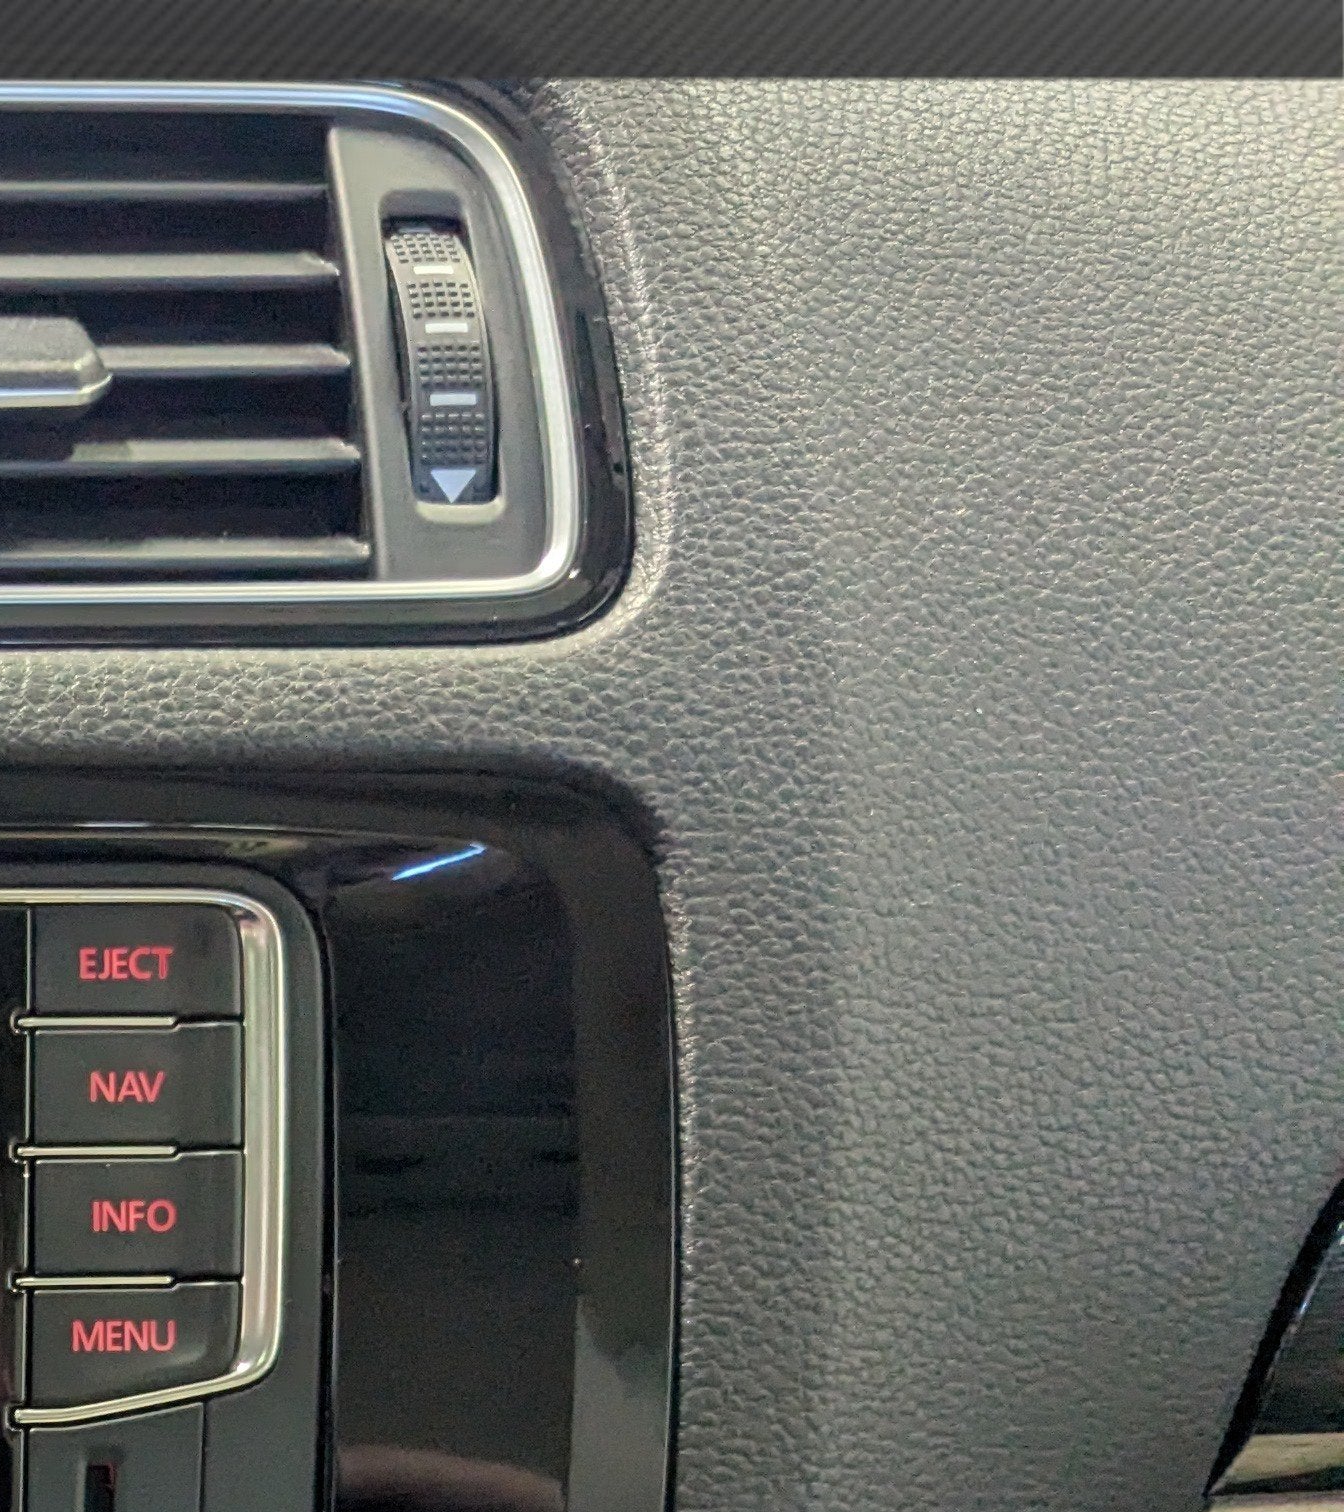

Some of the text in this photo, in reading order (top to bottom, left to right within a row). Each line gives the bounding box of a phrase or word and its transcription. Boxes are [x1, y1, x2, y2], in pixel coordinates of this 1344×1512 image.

[78, 946, 174, 980] EJECT
[89, 1070, 166, 1103] NAV
[90, 1199, 177, 1233] INFO
[71, 1320, 177, 1353] MENU
